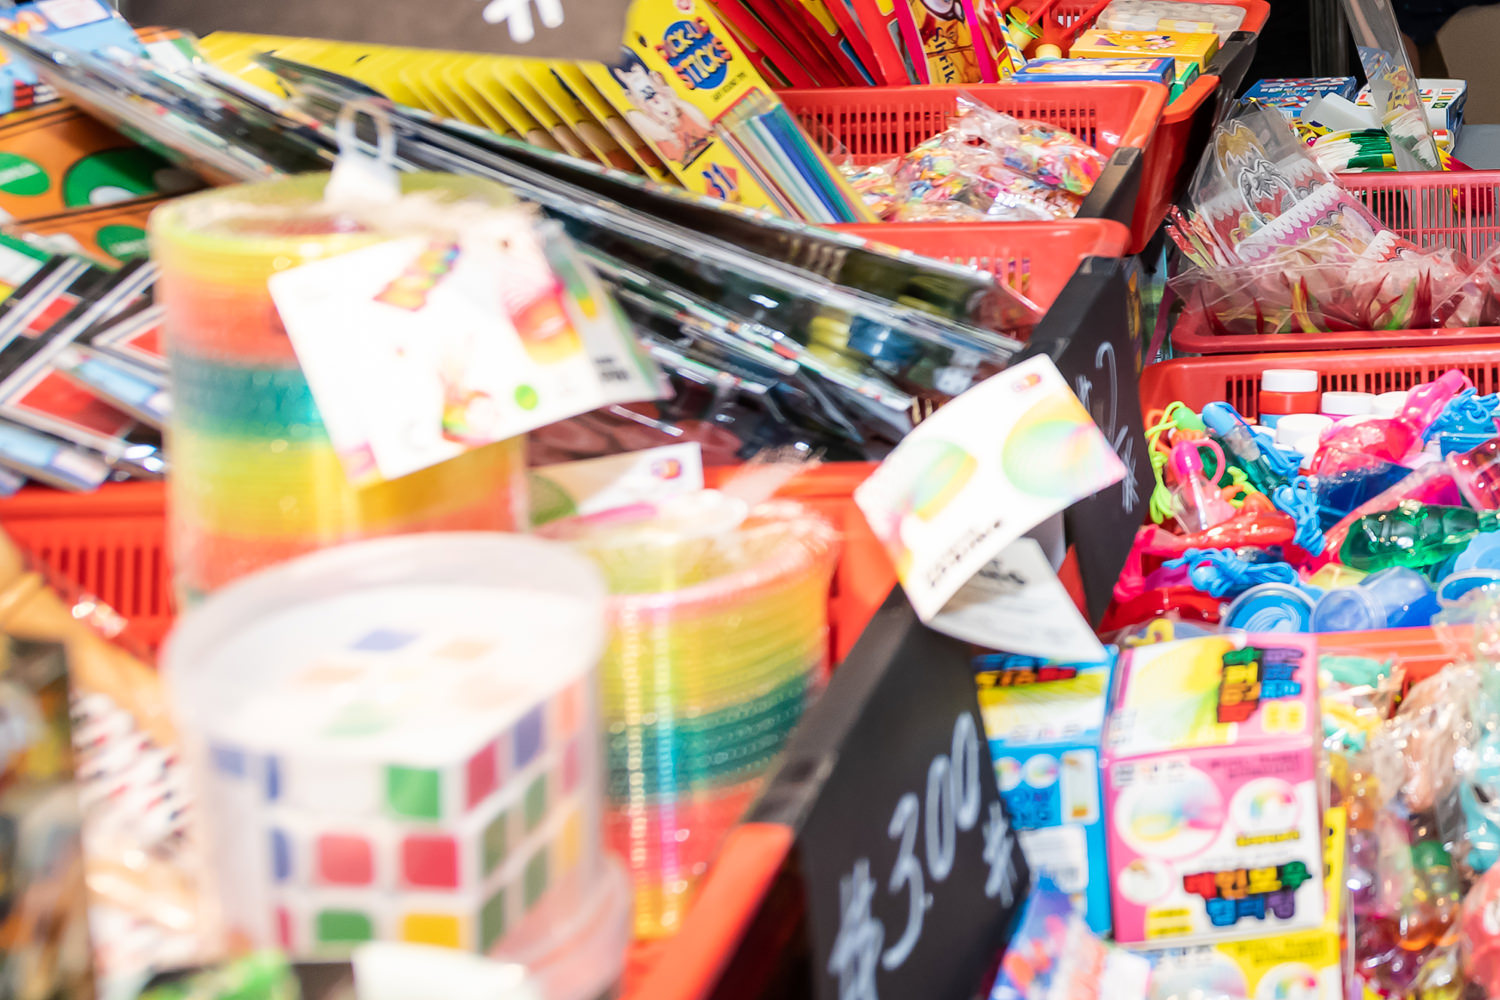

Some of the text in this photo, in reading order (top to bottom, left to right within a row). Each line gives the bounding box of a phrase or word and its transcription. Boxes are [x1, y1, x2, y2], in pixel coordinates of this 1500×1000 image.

[654, 16, 710, 60] PICK-UP
[673, 37, 733, 91] STICKS
[702, 163, 734, 200] 31
